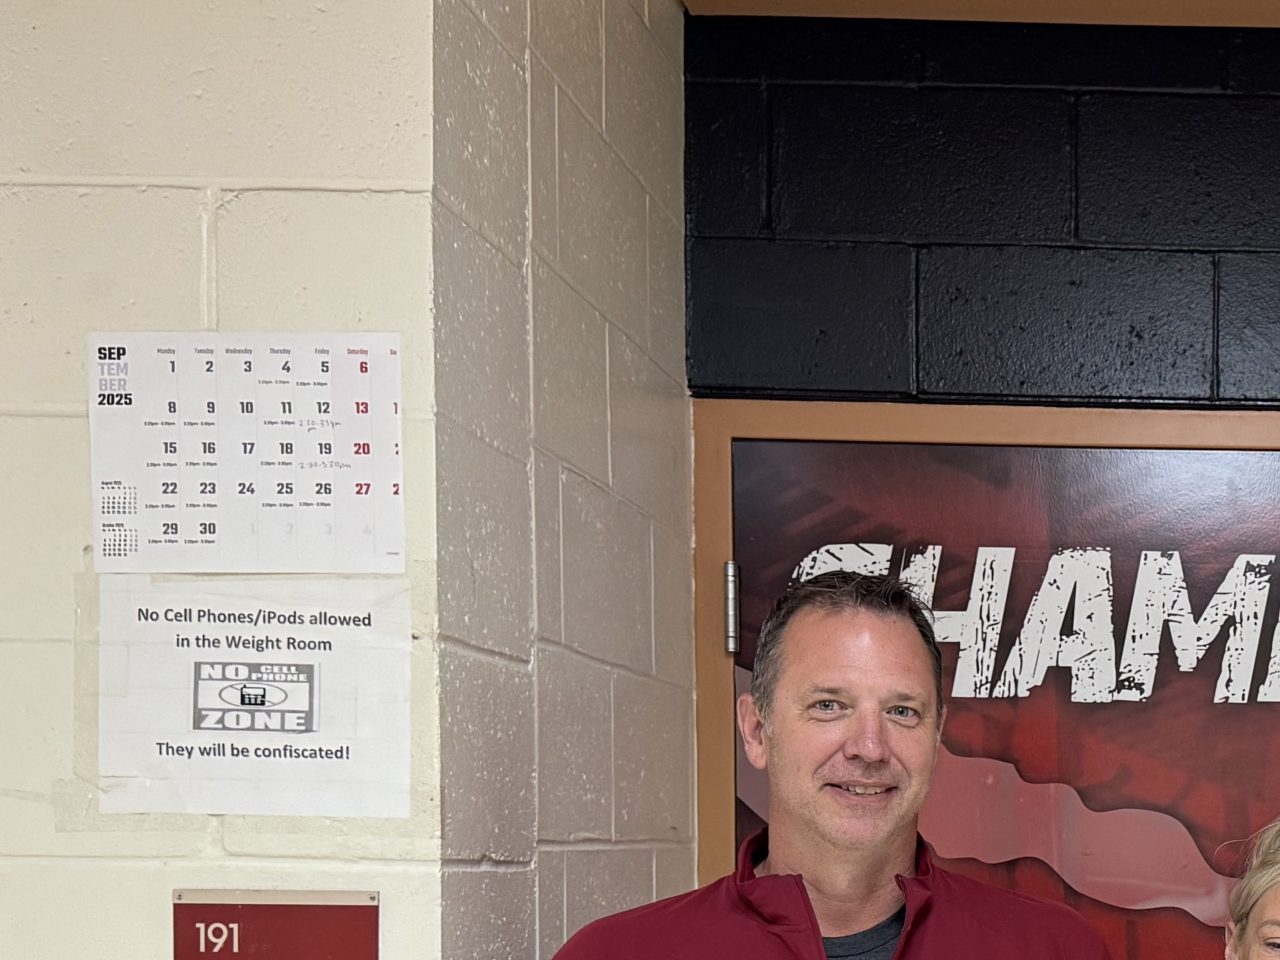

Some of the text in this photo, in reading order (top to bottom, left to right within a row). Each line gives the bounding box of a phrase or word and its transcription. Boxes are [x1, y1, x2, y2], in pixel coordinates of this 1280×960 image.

[97, 346, 127, 361] SEP
[97, 361, 129, 377] TEM
[169, 360, 369, 374] 1 2 3 4 5 6
[98, 377, 128, 392] BER
[97, 393, 133, 406] 2025
[167, 401, 177, 414] 8
[206, 401, 216, 414] 9
[239, 401, 254, 414] 10
[280, 401, 292, 414] 11
[316, 401, 330, 414] 12
[354, 401, 369, 414] 13
[163, 441, 371, 455] 15 16 17 18 19 20
[161, 482, 178, 495] 22
[199, 482, 216, 495] 23
[238, 482, 256, 495] 24
[276, 482, 294, 495] 25
[315, 482, 332, 495] 26
[355, 482, 371, 496] 27
[162, 522, 179, 535] 29
[199, 522, 217, 535] 30
[138, 608, 371, 626] No Cell Phones/iPods allowed
[177, 634, 331, 652] in the Weight Room
[200, 663, 249, 680] NO
[251, 672, 308, 682] PHONE
[260, 665, 298, 674] CELL
[200, 710, 306, 731] ZONE
[156, 742, 349, 759] They will be confiscated!
[195, 922, 240, 953] 191
